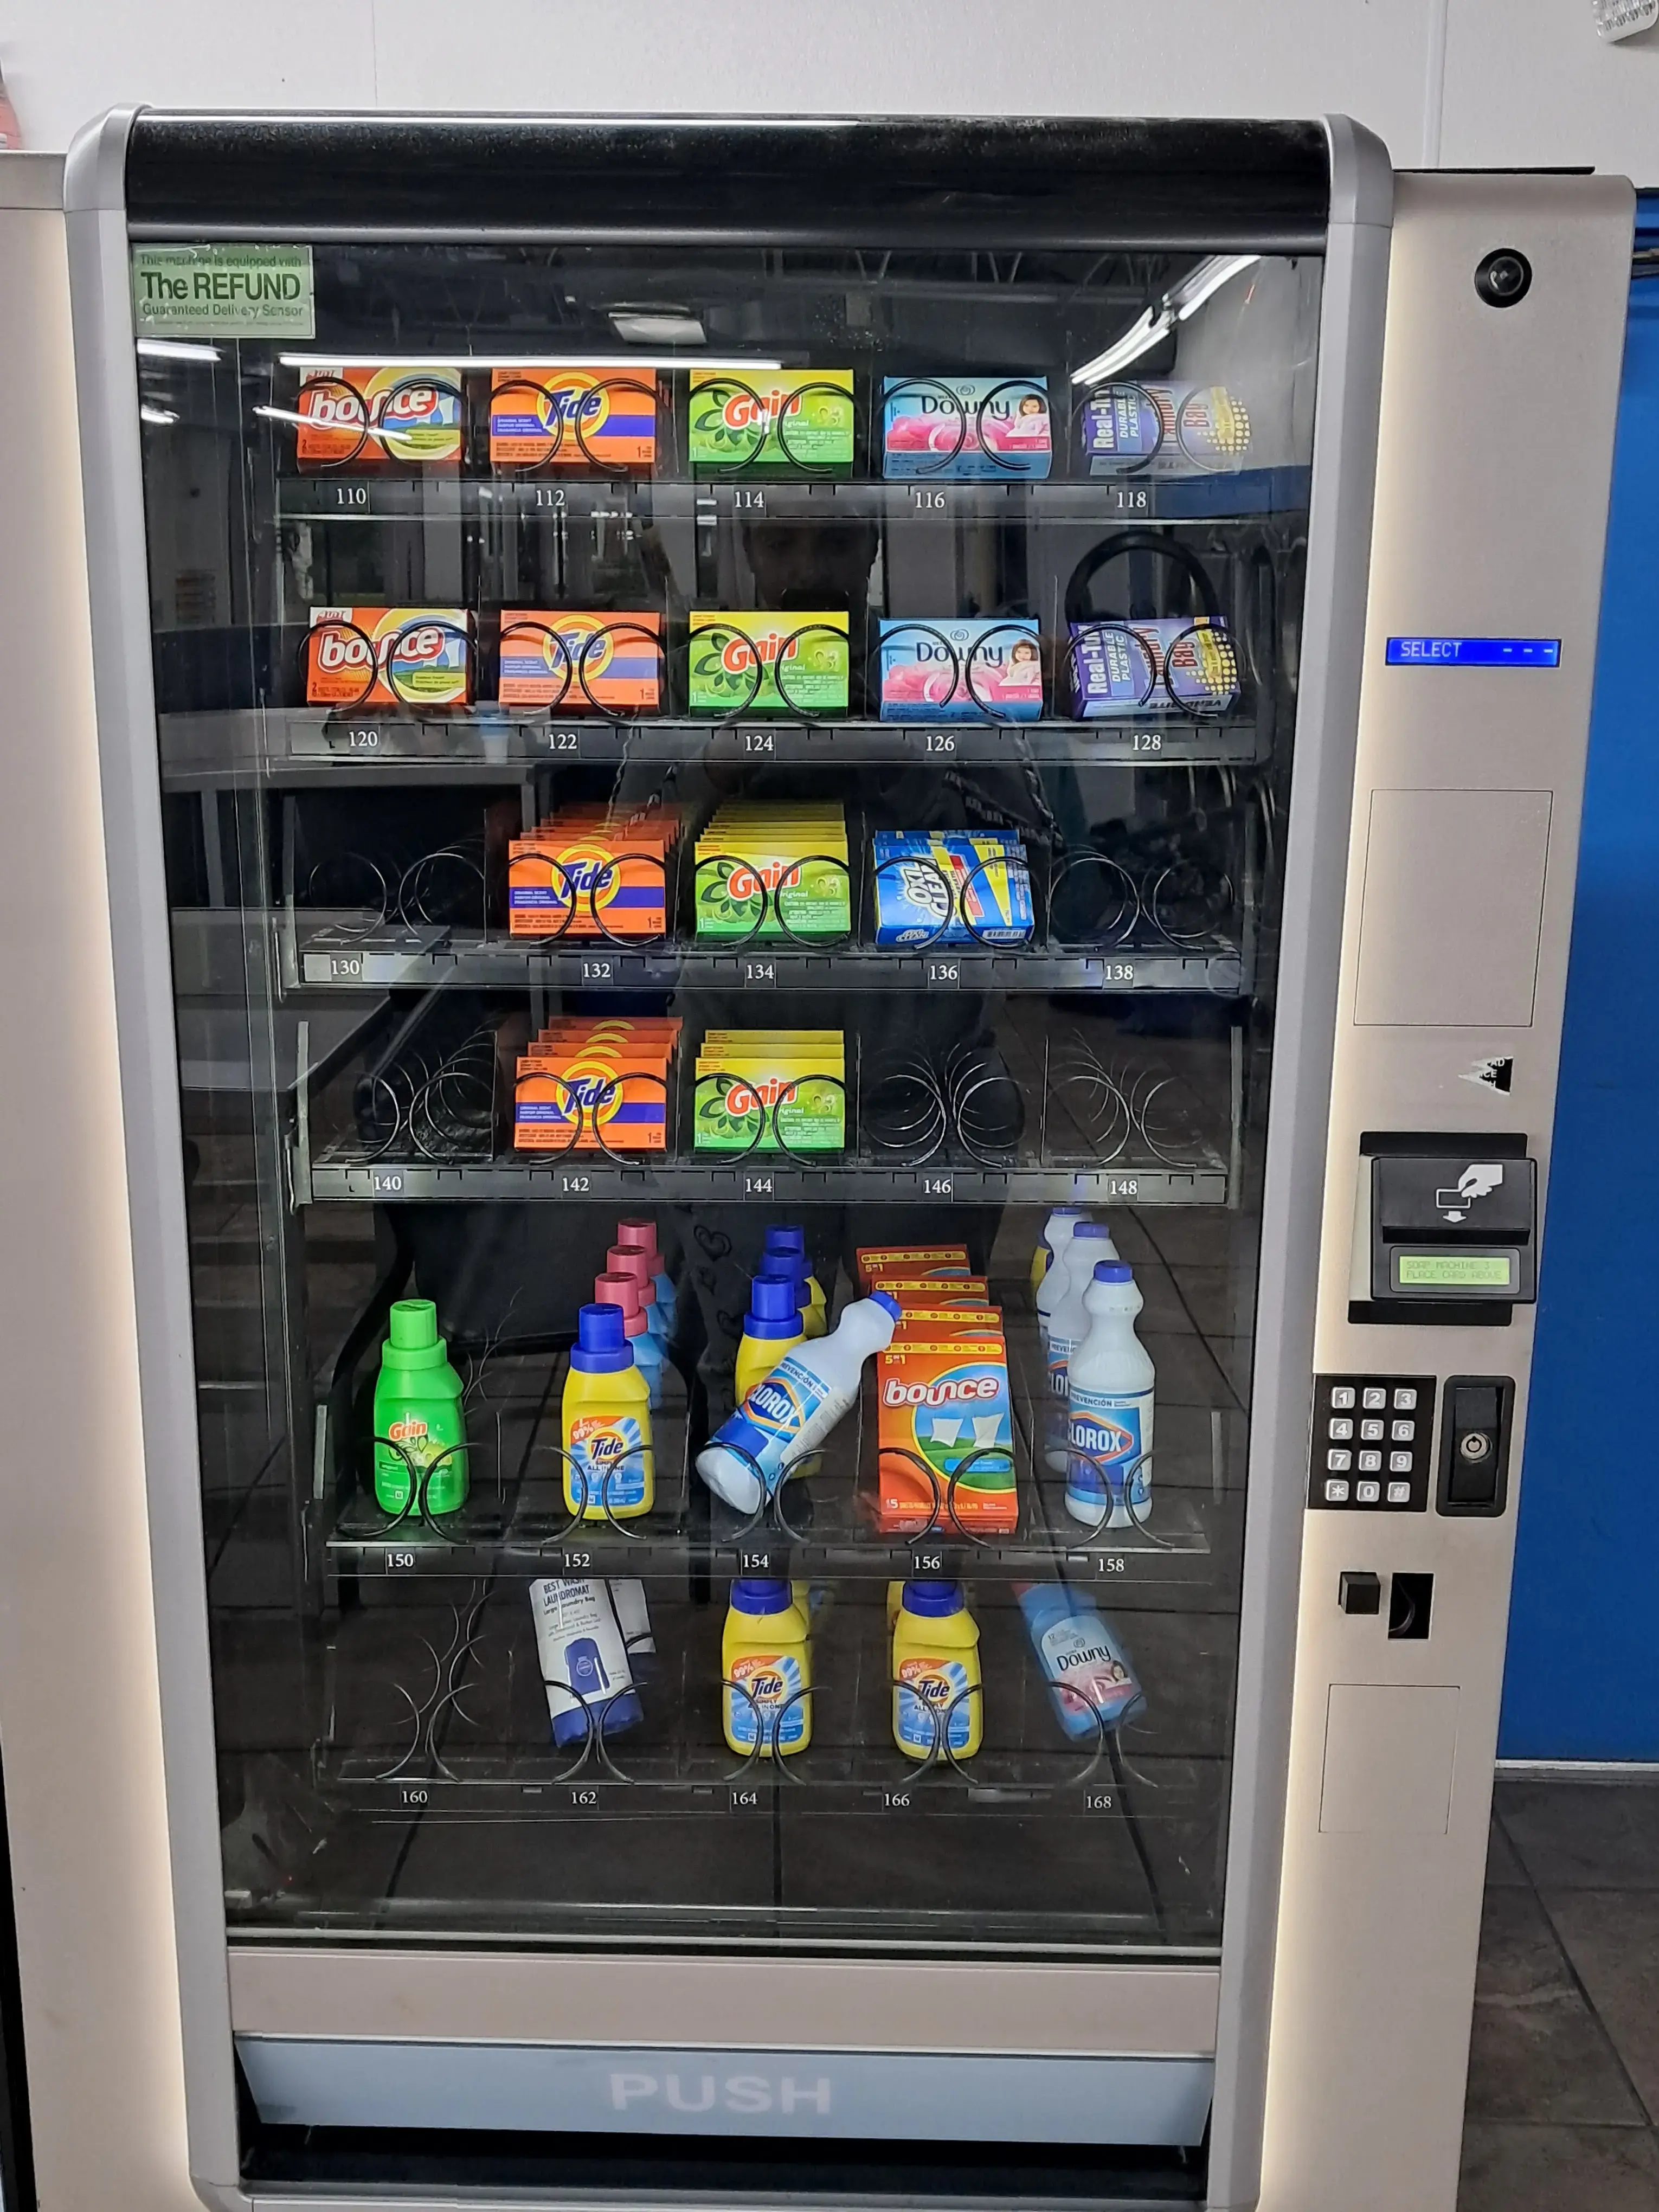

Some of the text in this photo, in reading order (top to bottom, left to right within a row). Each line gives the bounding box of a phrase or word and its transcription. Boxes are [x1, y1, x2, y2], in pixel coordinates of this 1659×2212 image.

[227, 255, 275, 268] equipped
[140, 272, 300, 300] The REFUND
[143, 303, 209, 316] Guaranteed
[262, 304, 303, 316] Sensor
[544, 389, 602, 428] Tide
[725, 390, 800, 427] Gain
[922, 395, 1010, 421] Downy
[337, 488, 366, 504] 110
[536, 490, 565, 506] 112
[735, 491, 764, 508] 114
[916, 492, 944, 508] 116
[1117, 492, 1146, 508] 118
[550, 632, 606, 668] Tide
[723, 633, 796, 671] Gain
[916, 642, 1003, 667] Downy
[1400, 641, 1462, 658] SELECT
[1104, 632, 1121, 683] DURABLE
[1115, 635, 1131, 681] PLASTIC
[349, 731, 378, 747] 120
[549, 734, 577, 749] 122
[745, 735, 774, 751] 124
[926, 736, 955, 751] 126
[1133, 735, 1161, 750] 128
[561, 861, 613, 898] Tide
[729, 861, 799, 899] Gain
[332, 960, 359, 975] 130
[583, 963, 611, 978] 132
[747, 964, 774, 979] 134
[931, 965, 957, 980] 136
[1105, 965, 1133, 980] 138
[563, 1078, 616, 1115] Tide
[726, 1078, 796, 1115] Gain
[374, 1177, 402, 1192] 140
[563, 1177, 589, 1191] 142
[745, 1178, 773, 1192] 144
[924, 1179, 951, 1193] 146
[1110, 1180, 1137, 1194] 148
[1406, 1271, 1436, 1279] PLACE
[884, 1378, 998, 1406] bounce
[1339, 1392, 1348, 1405] 1
[1368, 1392, 1380, 1405] 2
[1400, 1393, 1411, 1405] 3
[749, 1383, 796, 1428] LOROX
[390, 1422, 426, 1440] Gain
[1335, 1423, 1348, 1436] 4
[1367, 1424, 1378, 1436] 5
[1398, 1424, 1409, 1437] 6
[591, 1437, 623, 1460] Tide
[1335, 1454, 1347, 1467] 7
[1365, 1455, 1376, 1467] 8
[1396, 1455, 1407, 1468] 9
[1363, 1486, 1375, 1498] 0
[1393, 1486, 1405, 1497] #
[388, 1554, 414, 1567] 150
[565, 1553, 590, 1567] 152
[744, 1554, 768, 1567] 154
[915, 1556, 940, 1569] 156
[1099, 1558, 1124, 1572] 158
[543, 1580, 560, 1594] BEST
[543, 1584, 589, 1607] LAUNDROMAT
[562, 1598, 584, 1608] aundry
[1056, 1645, 1111, 1671] Downy
[751, 1676, 783, 1699] Tide
[918, 1680, 950, 1700] Tide
[403, 1790, 428, 1803] 160
[572, 1791, 596, 1804] 162
[733, 1792, 756, 1804] 164
[885, 1793, 910, 1806] 166
[1087, 1796, 1111, 1808] 168
[610, 2073, 831, 2114] PUSH
